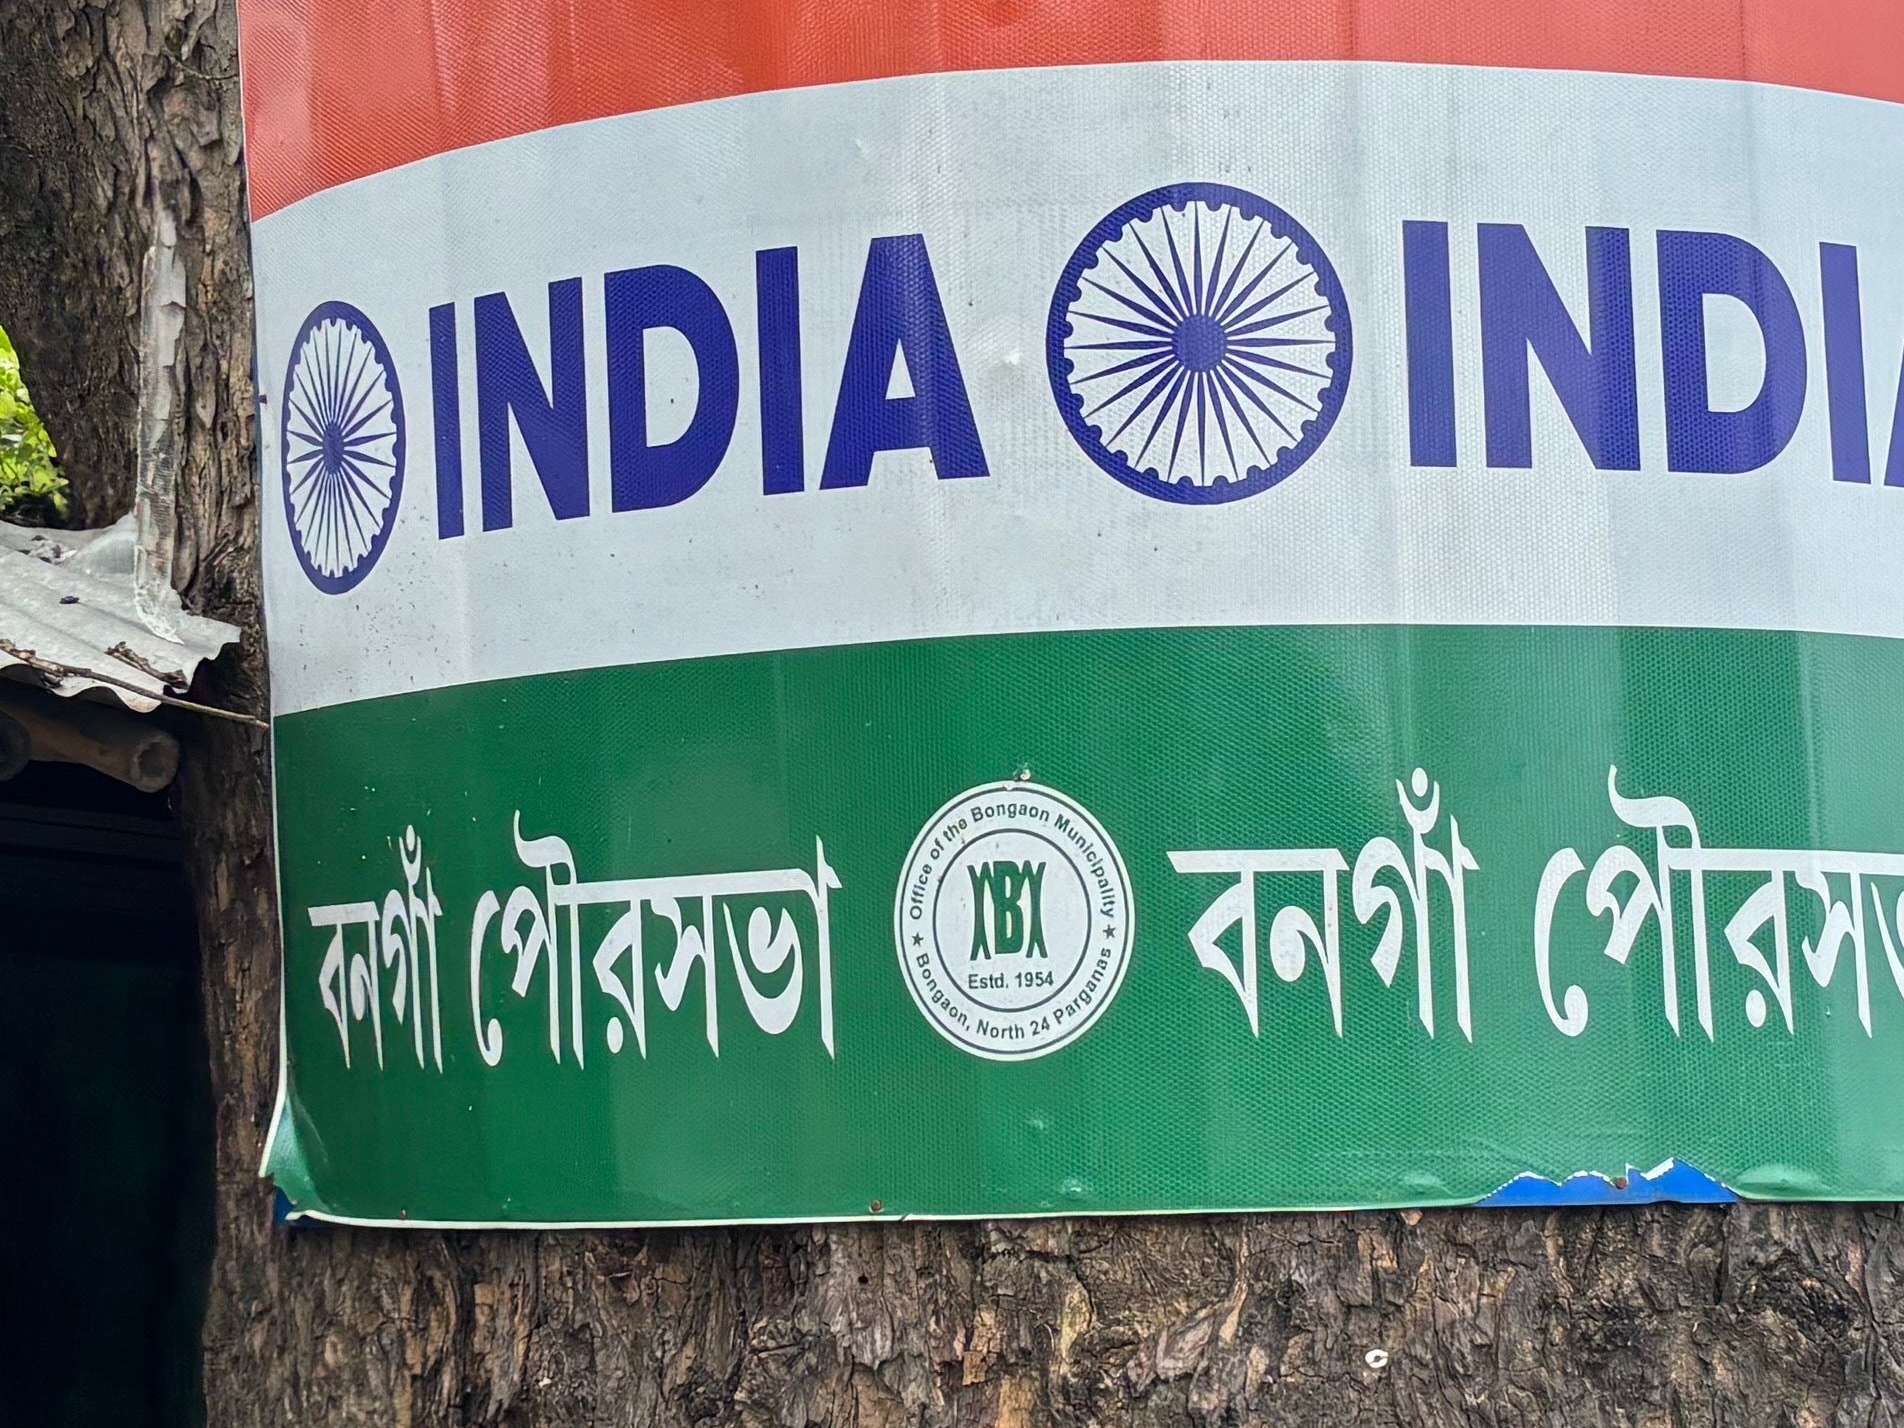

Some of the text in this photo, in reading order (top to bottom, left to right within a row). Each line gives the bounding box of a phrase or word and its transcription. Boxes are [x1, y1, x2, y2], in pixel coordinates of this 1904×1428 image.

[429, 233, 991, 541] INDIA
[307, 808, 843, 1074] বনগাঁ পৌরসভা
[909, 802, 1117, 920] Office of the Bongaon Municipality
[1166, 766, 1480, 1043] বনগাঁ
[916, 947, 1112, 1040] Bongaon, North 24 Parganas
[968, 971, 1054, 990] Estd. 1954
